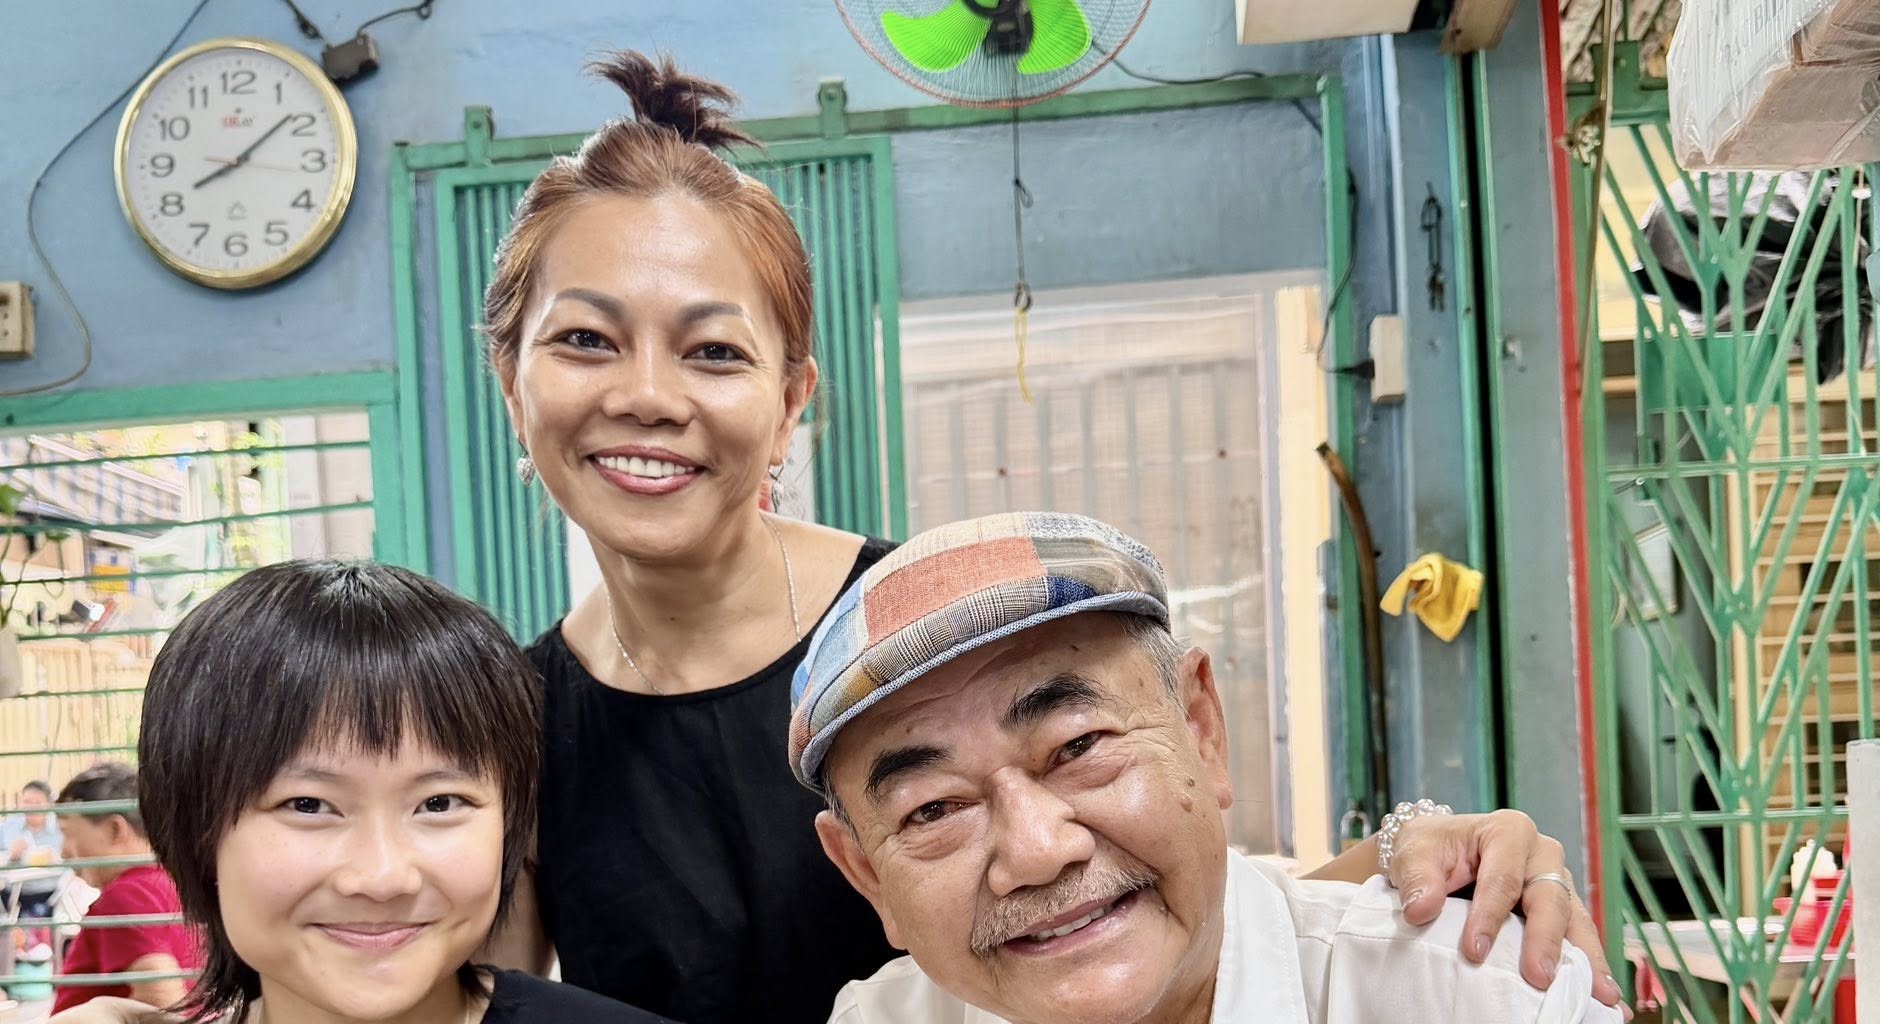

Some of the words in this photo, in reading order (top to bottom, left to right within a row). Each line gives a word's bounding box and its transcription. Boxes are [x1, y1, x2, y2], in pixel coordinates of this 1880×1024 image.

[220, 69, 257, 94] 12
[273, 82, 283, 105] 1
[188, 85, 209, 109] 11
[159, 116, 190, 141] 10
[291, 113, 317, 137] 2
[150, 154, 175, 178] 9
[301, 150, 326, 173] 3
[160, 192, 184, 216] 8
[290, 188, 315, 212] 4
[188, 222, 210, 246] 7
[224, 232, 248, 257] 6
[264, 220, 289, 246] 5
